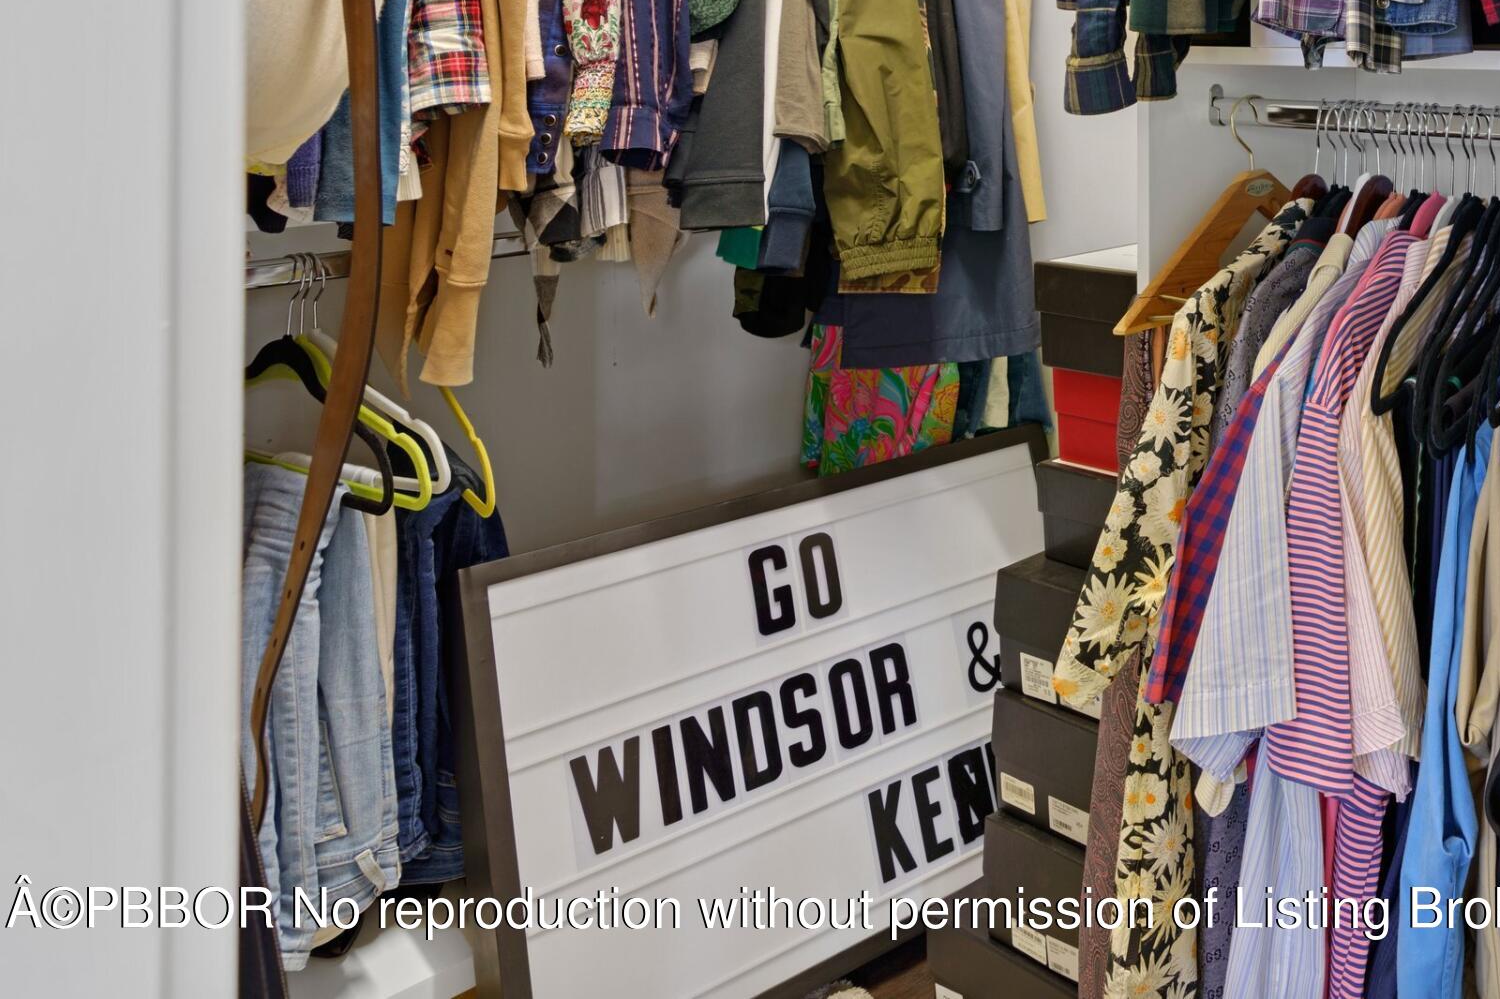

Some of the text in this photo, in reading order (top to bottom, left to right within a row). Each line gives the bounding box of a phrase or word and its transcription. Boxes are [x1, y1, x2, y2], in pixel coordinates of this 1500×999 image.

[748, 532, 843, 636] GO
[569, 621, 1002, 855] WINDSOR &
